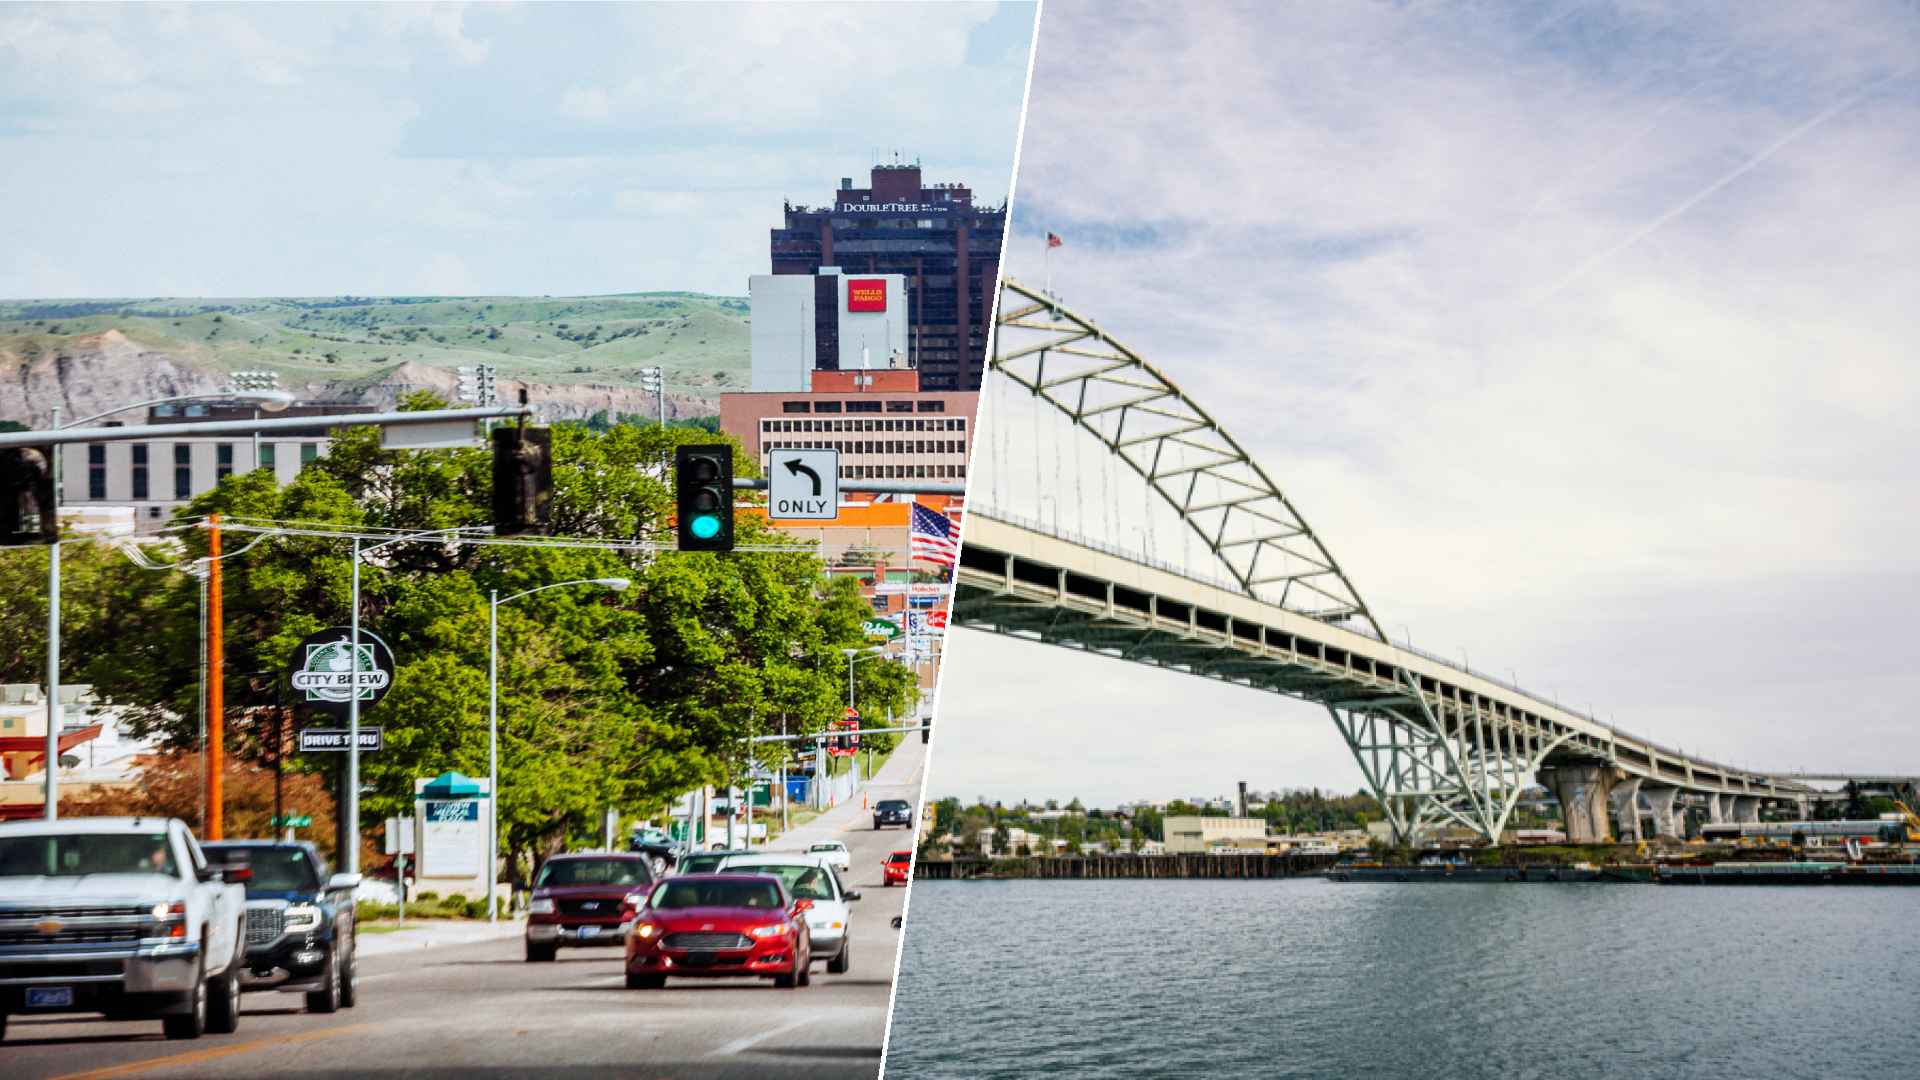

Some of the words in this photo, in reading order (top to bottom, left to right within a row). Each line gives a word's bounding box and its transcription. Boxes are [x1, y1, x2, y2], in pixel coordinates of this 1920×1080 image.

[778, 499, 827, 513] ONLY
[296, 674, 332, 685] CITY
[303, 734, 341, 746] DRIVE
[343, 734, 377, 745] TRU
